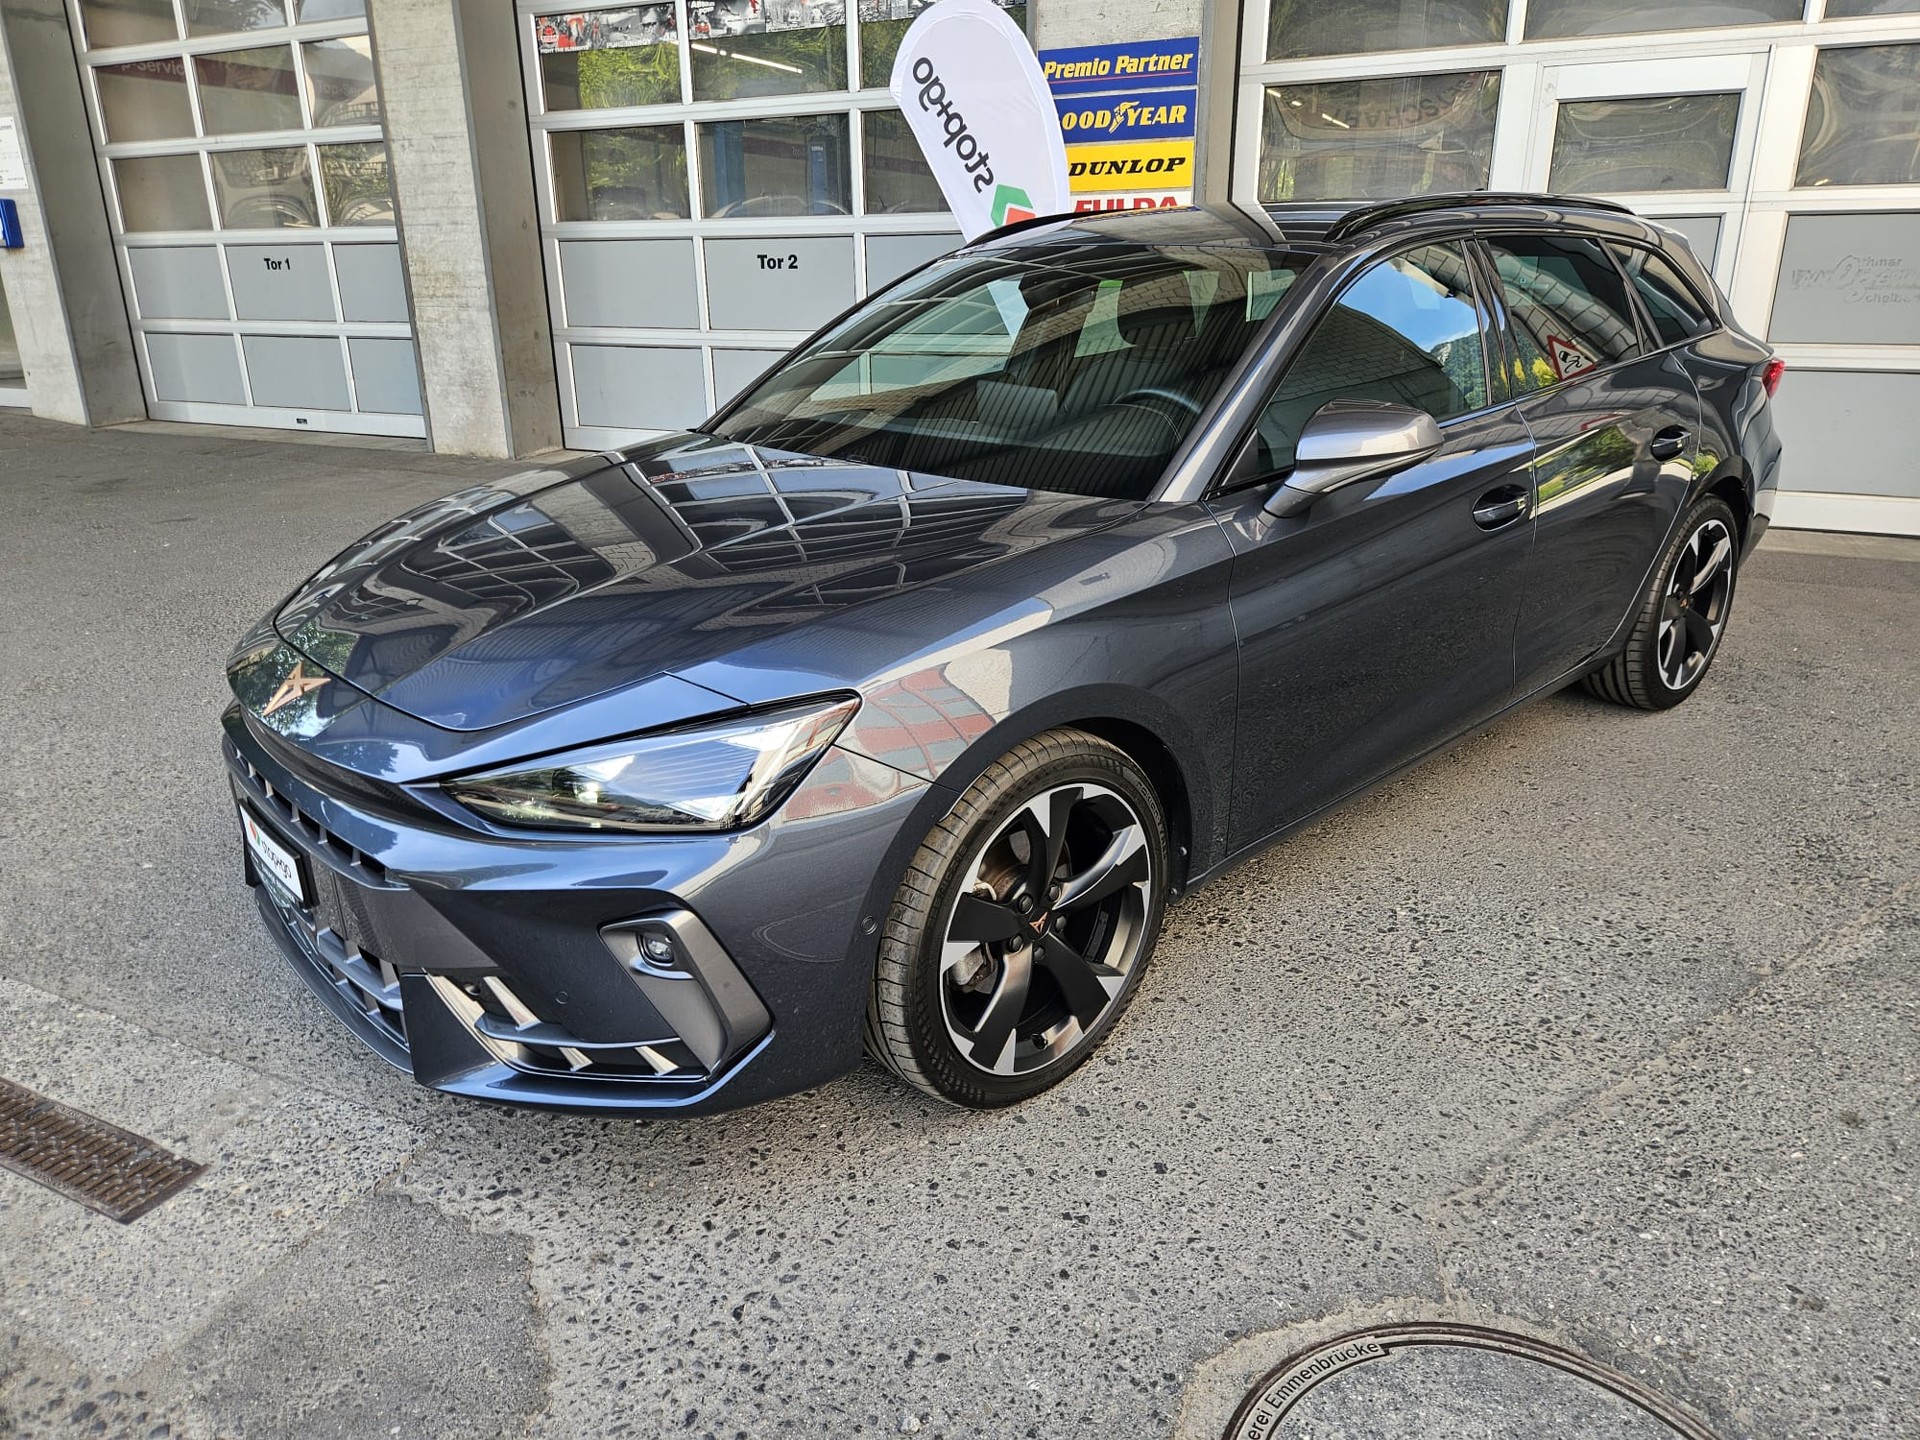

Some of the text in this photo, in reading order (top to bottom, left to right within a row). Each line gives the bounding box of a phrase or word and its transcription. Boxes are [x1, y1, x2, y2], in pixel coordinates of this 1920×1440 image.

[1043, 53, 1194, 79] Premio Partner
[1061, 104, 1188, 131] OODYEAR
[1068, 157, 1187, 177] DUNLOP
[263, 257, 291, 270] Tor 1
[756, 254, 799, 269] Tor 2
[1264, 1342, 1379, 1409] Emmenbrücke
